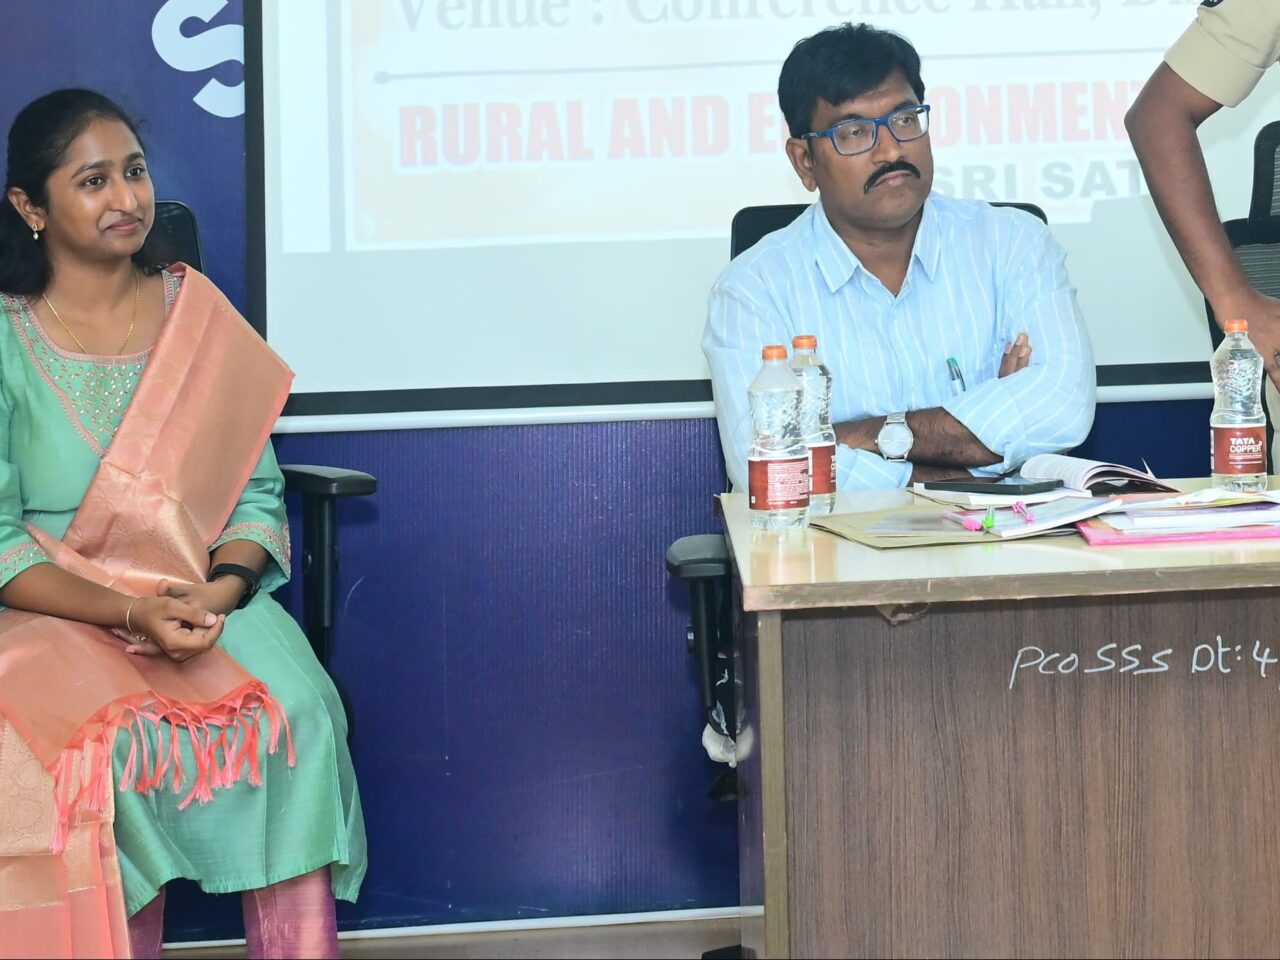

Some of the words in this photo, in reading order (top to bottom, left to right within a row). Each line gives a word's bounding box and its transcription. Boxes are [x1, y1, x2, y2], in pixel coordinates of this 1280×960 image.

[400, 100, 595, 169] RURAL
[607, 95, 731, 160] AND
[1041, 158, 1143, 200] SAT
[1230, 437, 1255, 445] TATA
[1230, 444, 1262, 453] COPPER
